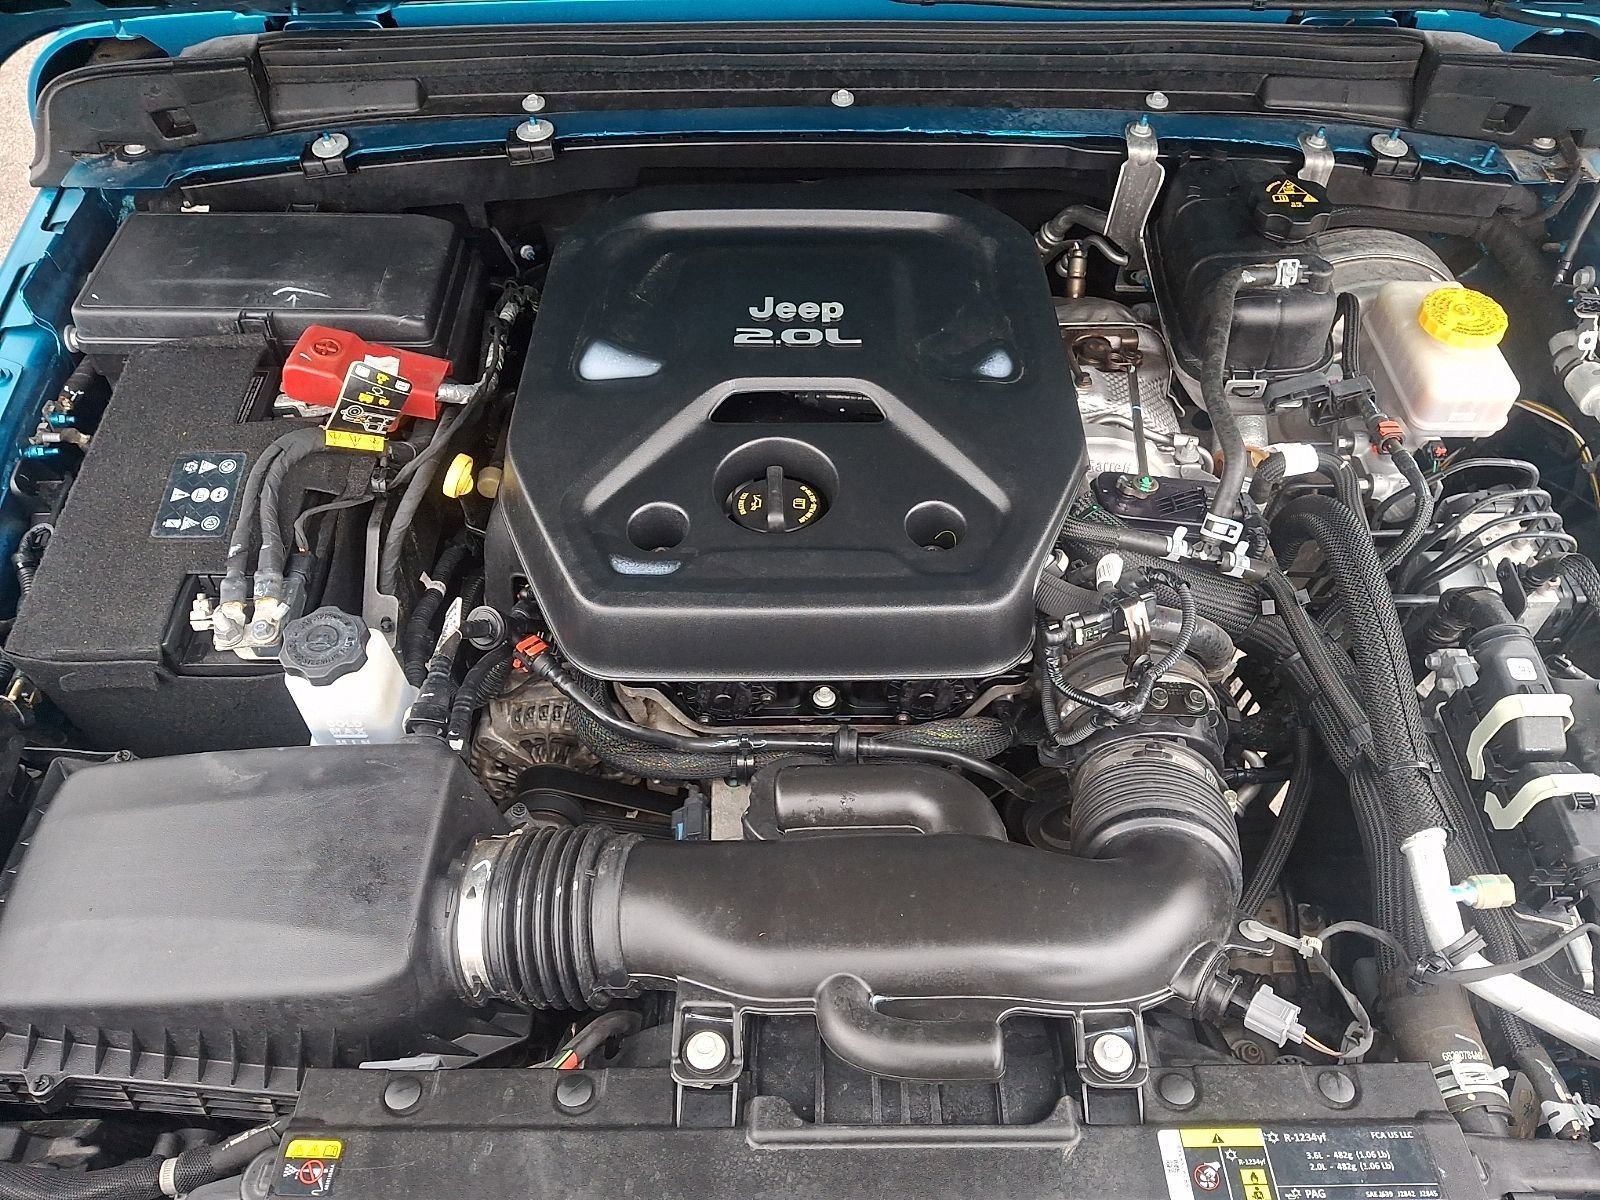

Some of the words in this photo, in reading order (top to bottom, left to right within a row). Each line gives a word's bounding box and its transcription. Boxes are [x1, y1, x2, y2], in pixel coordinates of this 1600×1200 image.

[749, 296, 844, 324] Jeep
[733, 327, 862, 347] 2.0L
[1284, 1132, 1326, 1144] R-1234yf
[1371, 1131, 1387, 1140] FCA
[1388, 1131, 1400, 1139] US
[1400, 1131, 1414, 1139] LLC
[1306, 1152, 1324, 1160] 3.6L
[1333, 1151, 1353, 1161] 482g
[1356, 1150, 1376, 1160] (1.06
[1310, 1162, 1327, 1171] 2.0L
[1336, 1162, 1357, 1172] 482g
[1360, 1161, 1380, 1171] (1.06
[1305, 1189, 1326, 1199] PAG
